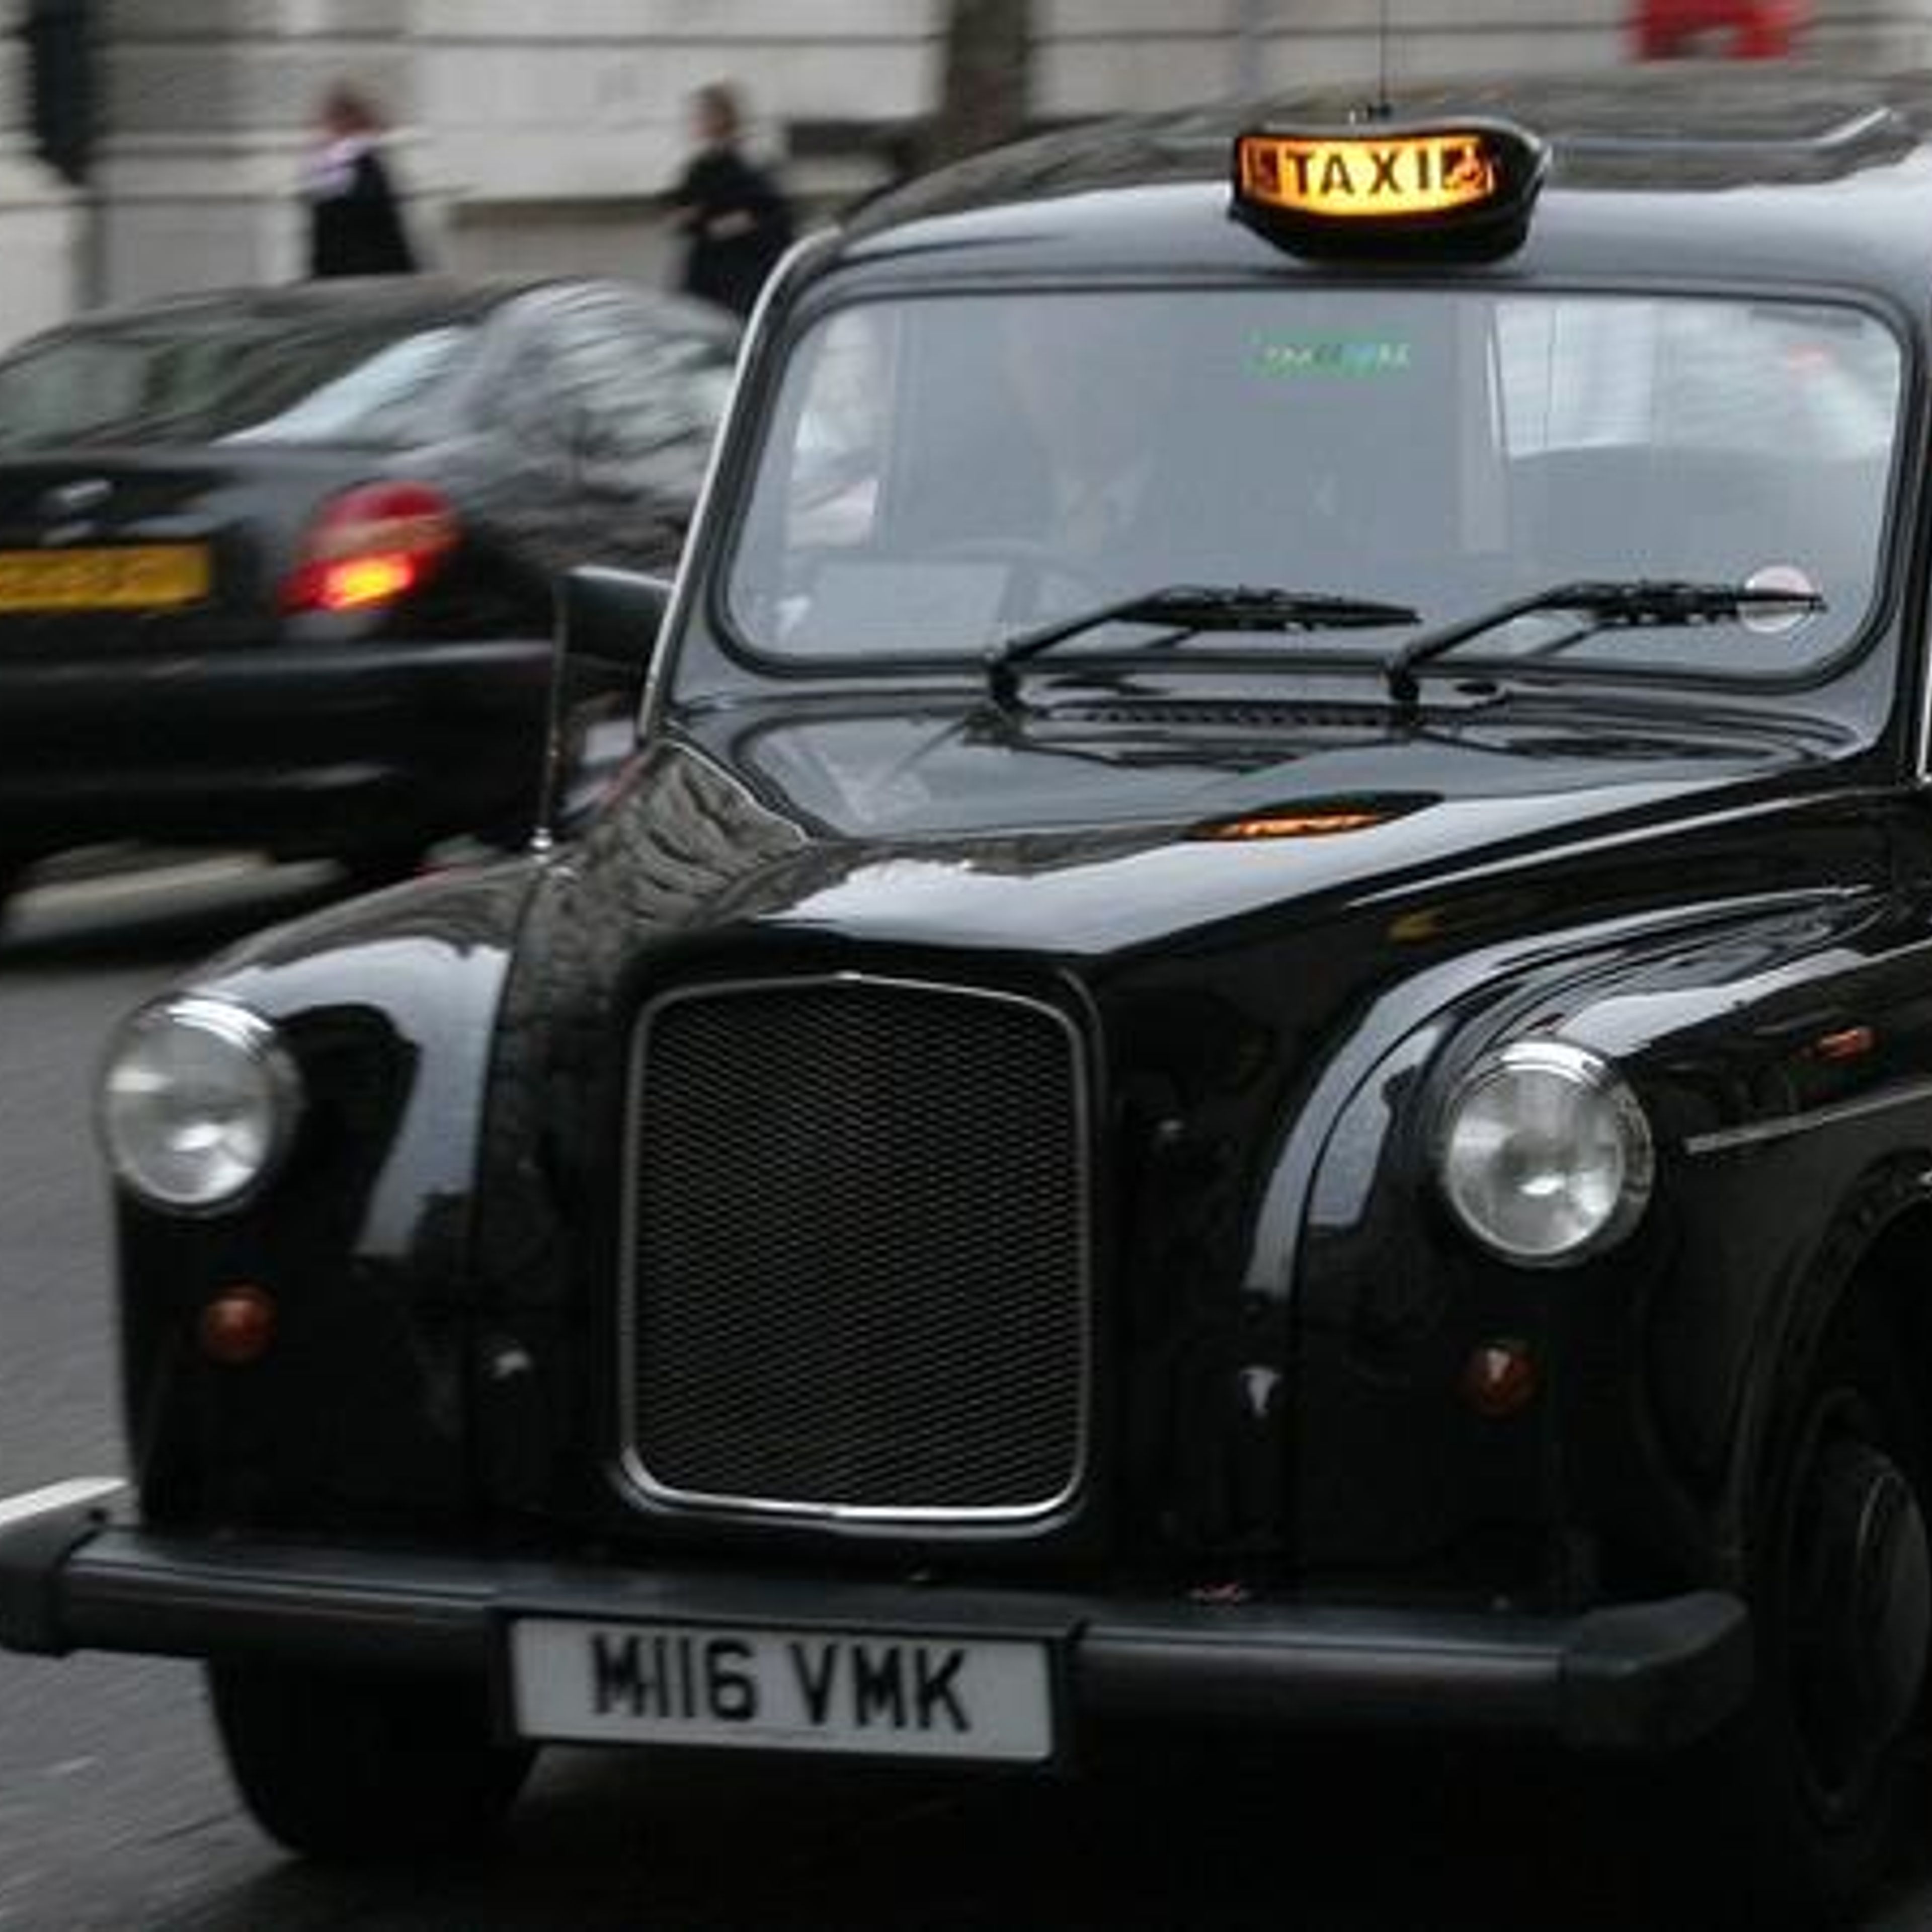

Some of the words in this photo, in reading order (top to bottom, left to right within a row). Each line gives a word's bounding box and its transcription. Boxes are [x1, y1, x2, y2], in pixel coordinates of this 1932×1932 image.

[1286, 147, 1429, 196] TAXI
[593, 1633, 759, 1722] M116
[791, 1642, 972, 1732] VMK
